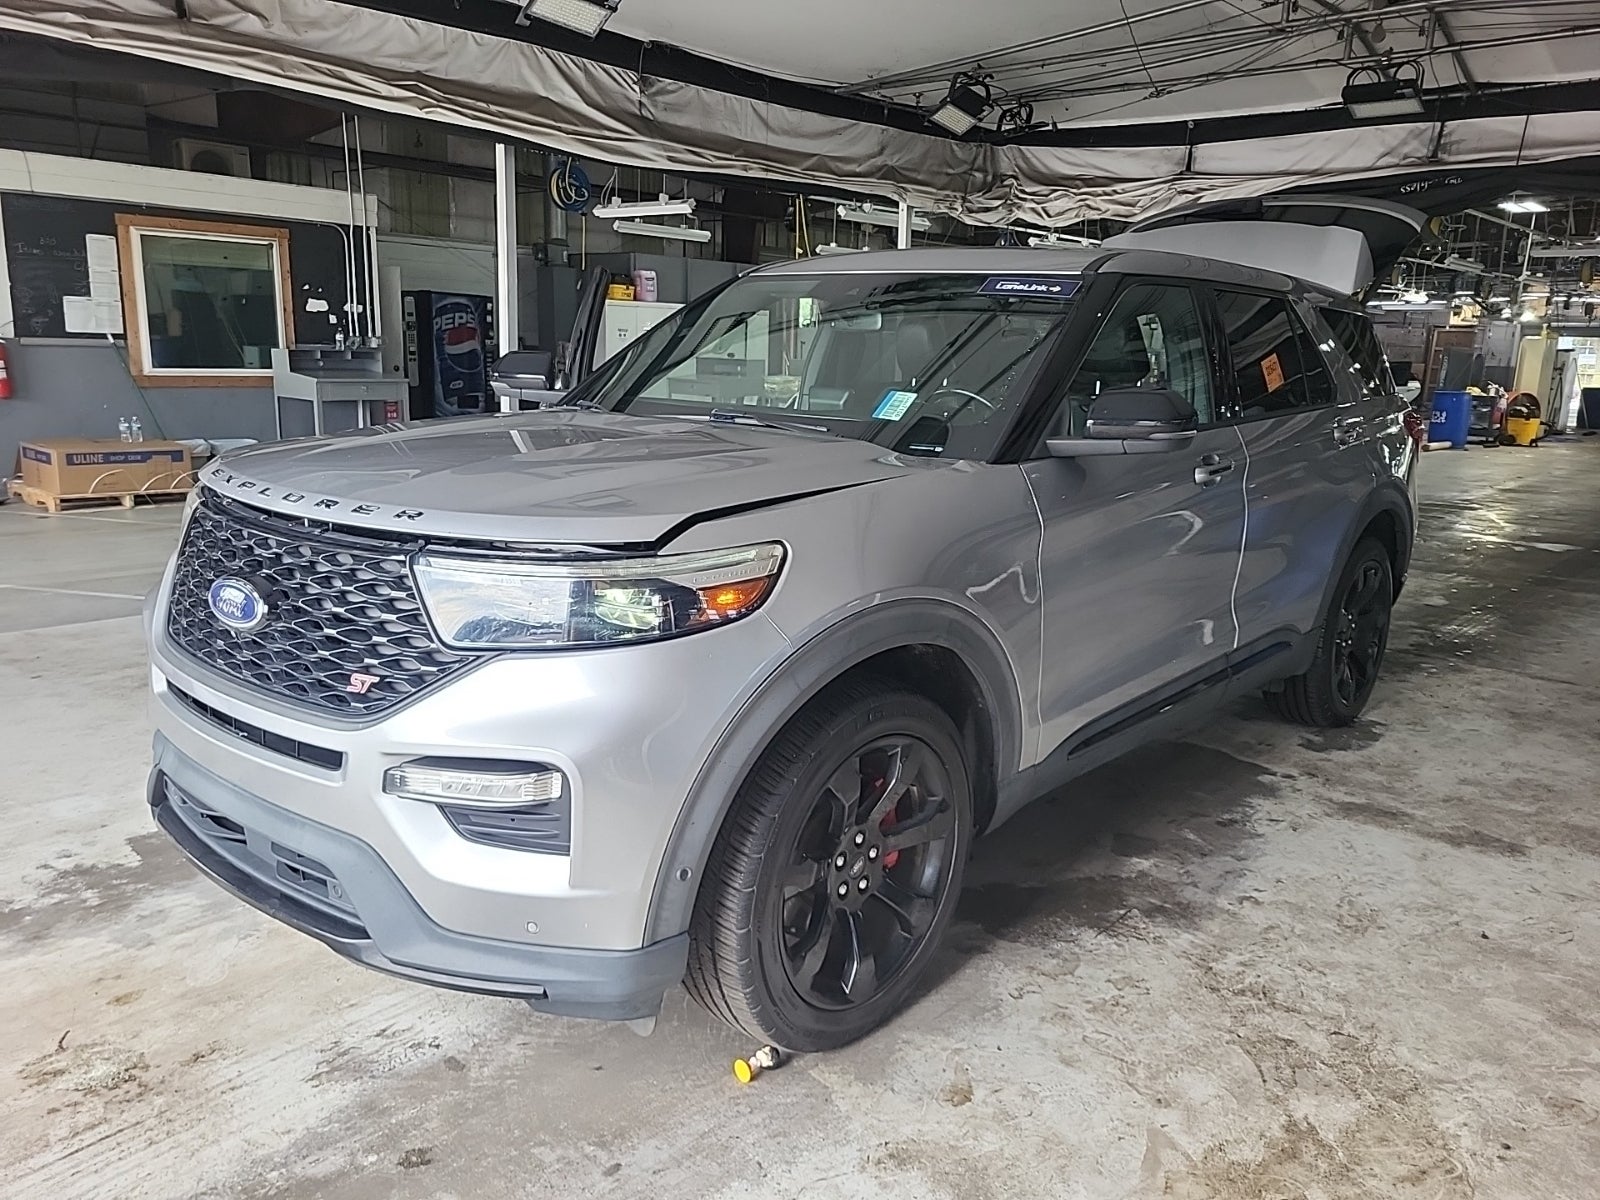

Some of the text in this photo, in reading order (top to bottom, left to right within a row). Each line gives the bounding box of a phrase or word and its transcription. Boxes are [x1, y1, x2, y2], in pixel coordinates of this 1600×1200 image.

[73, 453, 104, 464] ULINE
[211, 468, 424, 521] EXPLORER
[346, 673, 380, 694] ST
